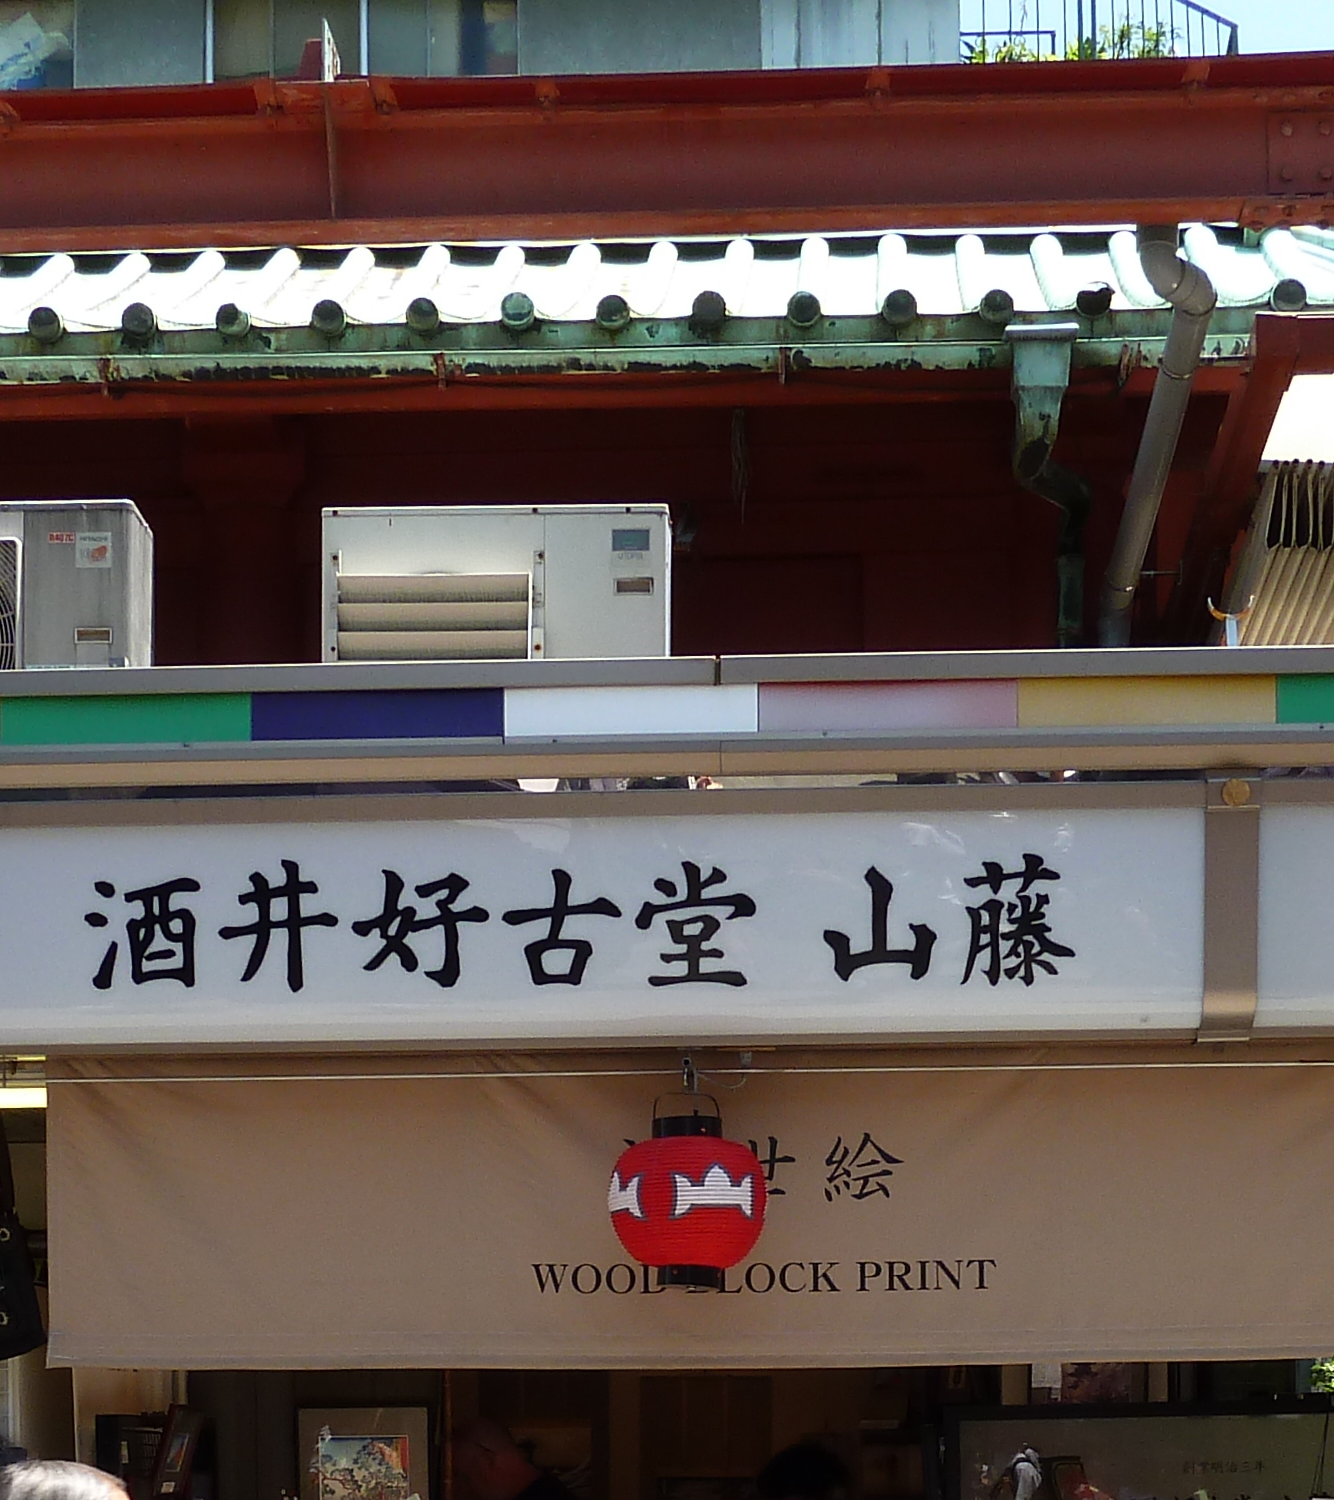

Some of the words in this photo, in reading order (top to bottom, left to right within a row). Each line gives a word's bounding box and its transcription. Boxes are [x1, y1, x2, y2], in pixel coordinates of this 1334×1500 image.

[84, 859, 757, 993] 酒井好古堂
[823, 853, 1076, 987] 山藤
[855, 1258, 998, 1293] PRINT
